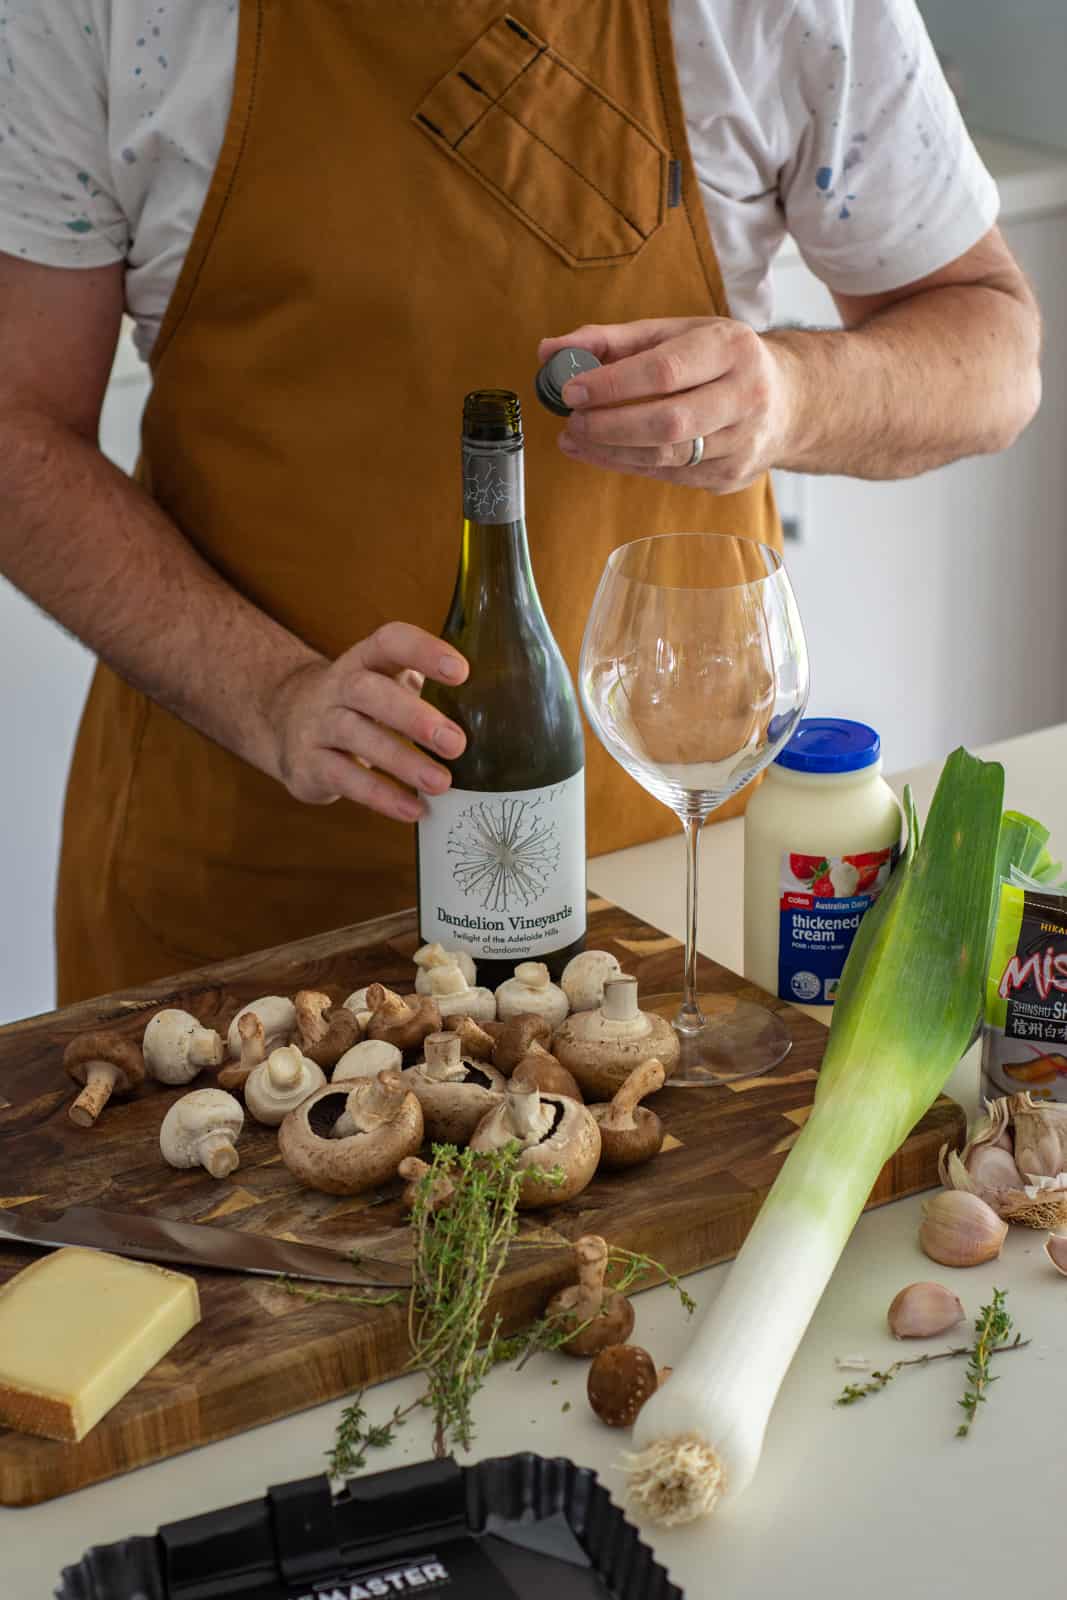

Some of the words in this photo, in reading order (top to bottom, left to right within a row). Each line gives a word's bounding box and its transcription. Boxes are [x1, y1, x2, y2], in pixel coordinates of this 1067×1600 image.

[815, 902, 850, 910] Australian
[437, 907, 504, 931] Dandelion
[508, 905, 573, 930] Vineyards
[792, 914, 860, 929] thickened
[792, 928, 835, 942] cream
[1040, 923, 1067, 935] HIKA
[453, 930, 480, 943] Twilight
[482, 934, 490, 943] of
[507, 934, 543, 943] Adelaide
[482, 944, 531, 954] Chardonnay
[1012, 1002, 1051, 1017] SHINSHU
[287, 1561, 449, 1600] MASTER
